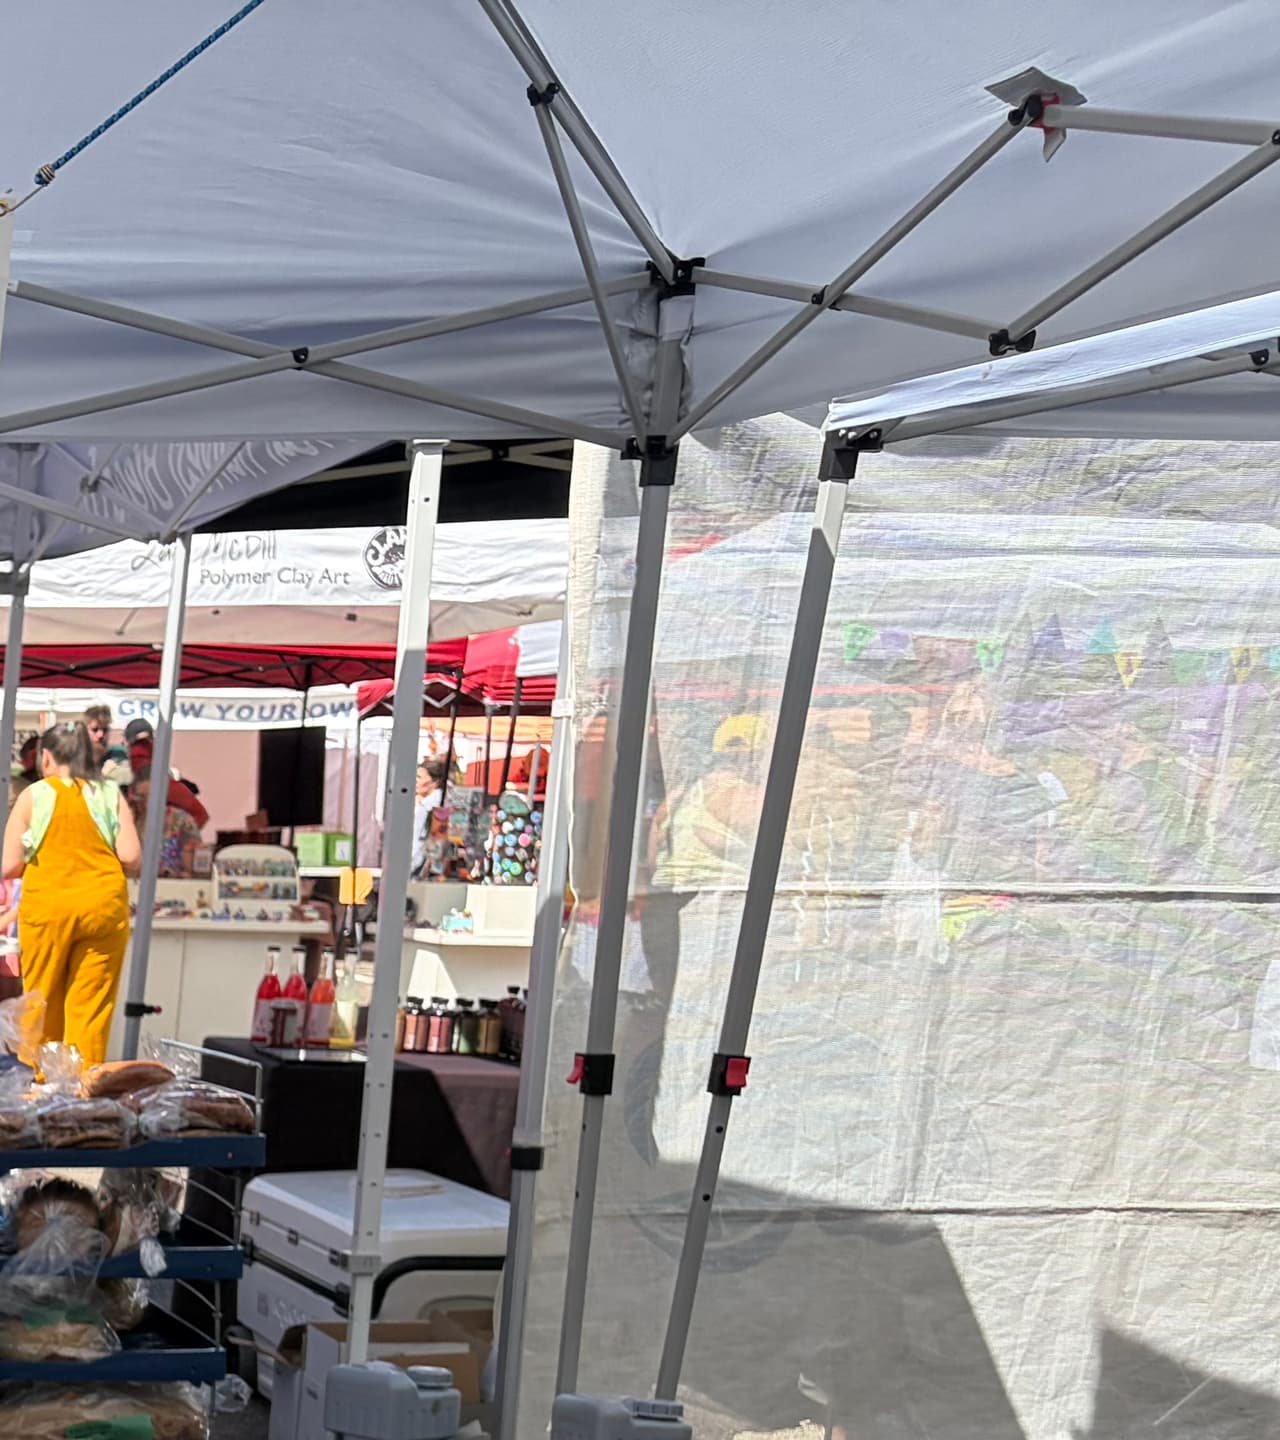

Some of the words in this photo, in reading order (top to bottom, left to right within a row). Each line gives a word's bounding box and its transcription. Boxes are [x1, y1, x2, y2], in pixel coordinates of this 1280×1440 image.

[200, 568, 271, 588] Polymer
[278, 568, 314, 588] Clay
[320, 568, 350, 585] Art
[118, 700, 203, 719] GRW
[216, 700, 297, 721] YOUR
[308, 700, 354, 718] OW
